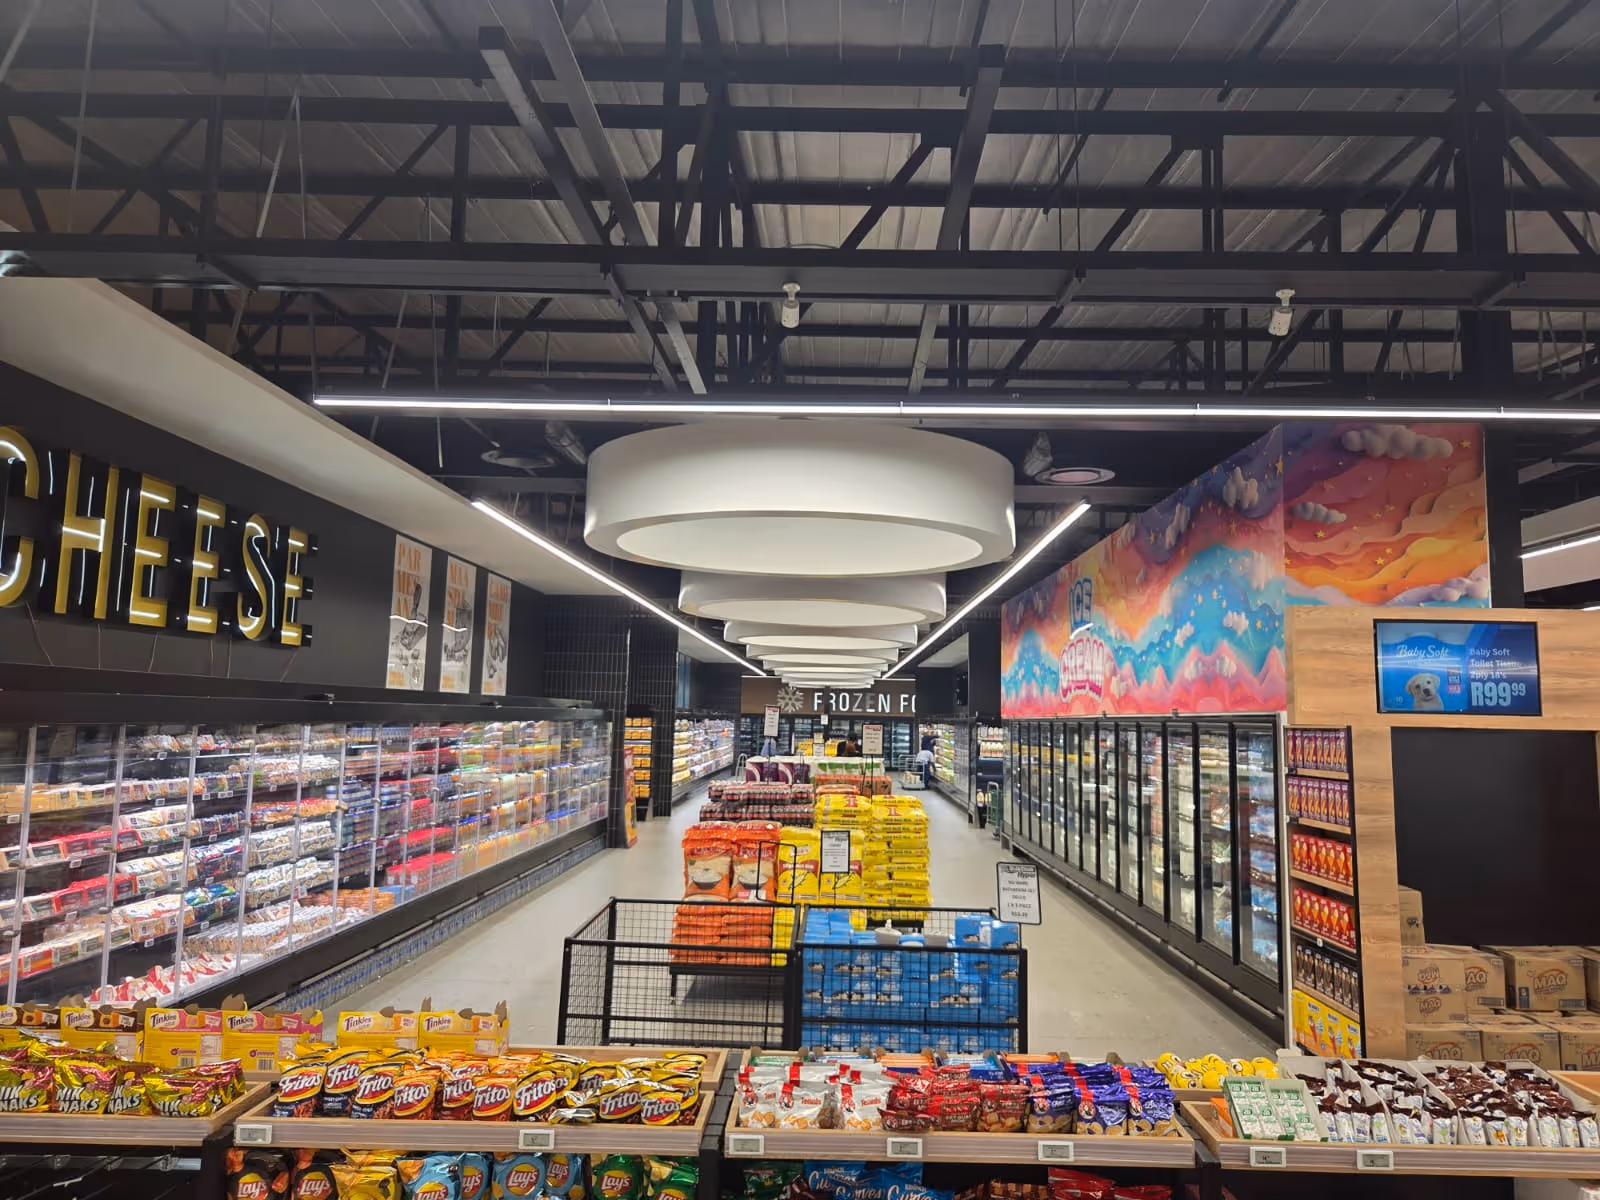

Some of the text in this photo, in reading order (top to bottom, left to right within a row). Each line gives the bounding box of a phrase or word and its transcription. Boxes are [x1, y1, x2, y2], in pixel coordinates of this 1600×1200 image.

[0, 426, 308, 646] CHEESE
[1069, 577, 1094, 632] ICE
[1396, 645, 1449, 658] Baby Soft
[1470, 648, 1511, 657] Baby Soft
[1060, 638, 1105, 702] CREAM
[1470, 659, 1494, 668] Toilet
[814, 692, 891, 713] FROZEN
[1466, 971, 1488, 985] AQ
[1534, 973, 1568, 989] MAQ
[65, 1011, 92, 1027] Tinkies
[151, 1011, 177, 1028] Tinkies
[227, 1014, 254, 1030] Tinkies
[344, 1015, 372, 1031] Tinkies
[425, 1016, 451, 1032] Tinkies
[279, 1073, 322, 1096] Fritos
[57, 1087, 85, 1101] NIK
[473, 1085, 510, 1110] Fritos
[515, 1079, 556, 1111] Fritos
[58, 1098, 100, 1114] NAKS
[640, 1099, 680, 1119] Fritos
[547, 1161, 569, 1179] Lay's
[299, 1178, 331, 1197] Lay's
[508, 1169, 539, 1189] Lay's
[601, 1175, 631, 1191] Lay's
[238, 1181, 268, 1200] Lay's
